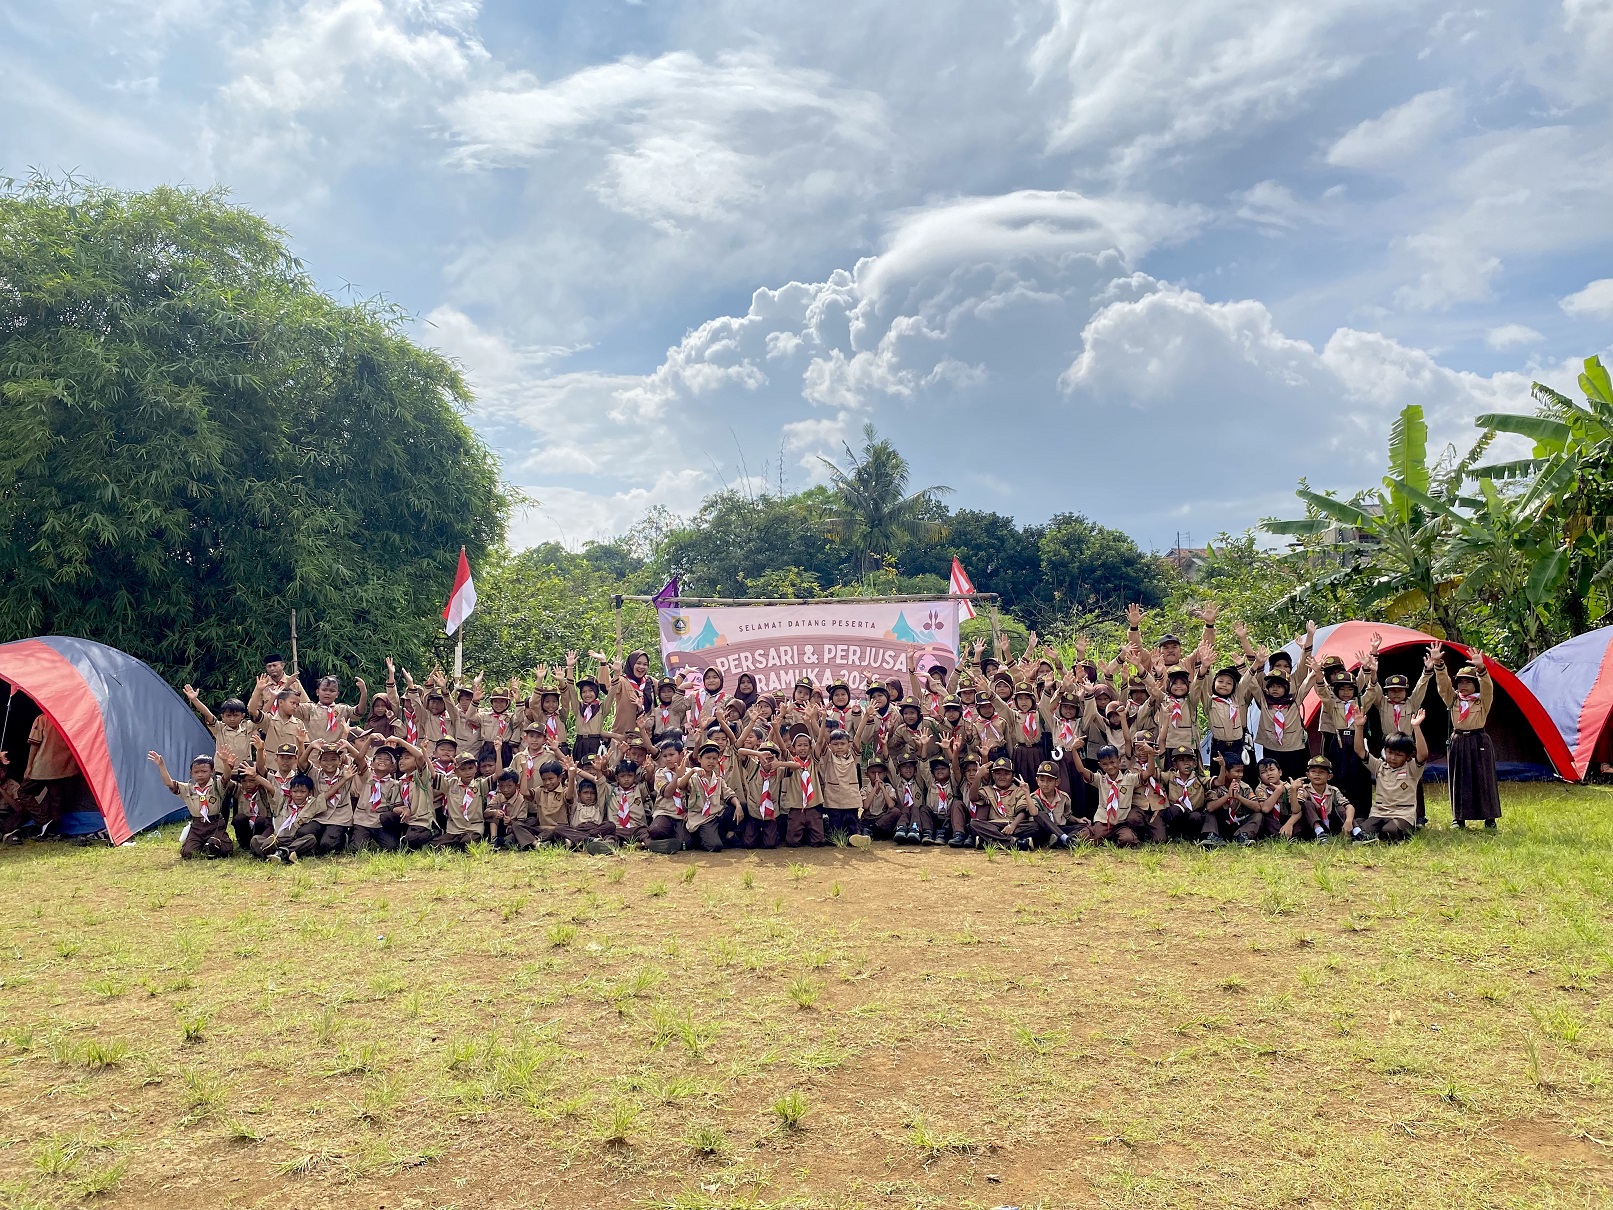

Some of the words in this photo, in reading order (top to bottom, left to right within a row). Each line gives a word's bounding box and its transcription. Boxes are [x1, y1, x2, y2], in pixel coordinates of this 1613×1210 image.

[739, 621, 782, 632] SELAMAT
[788, 619, 826, 627] DATANG
[832, 619, 876, 629] PESERTA
[715, 645, 799, 676] PERSARI
[803, 645, 819, 664] &
[823, 645, 907, 673] PERJUSA
[755, 667, 833, 692] RAMUKA
